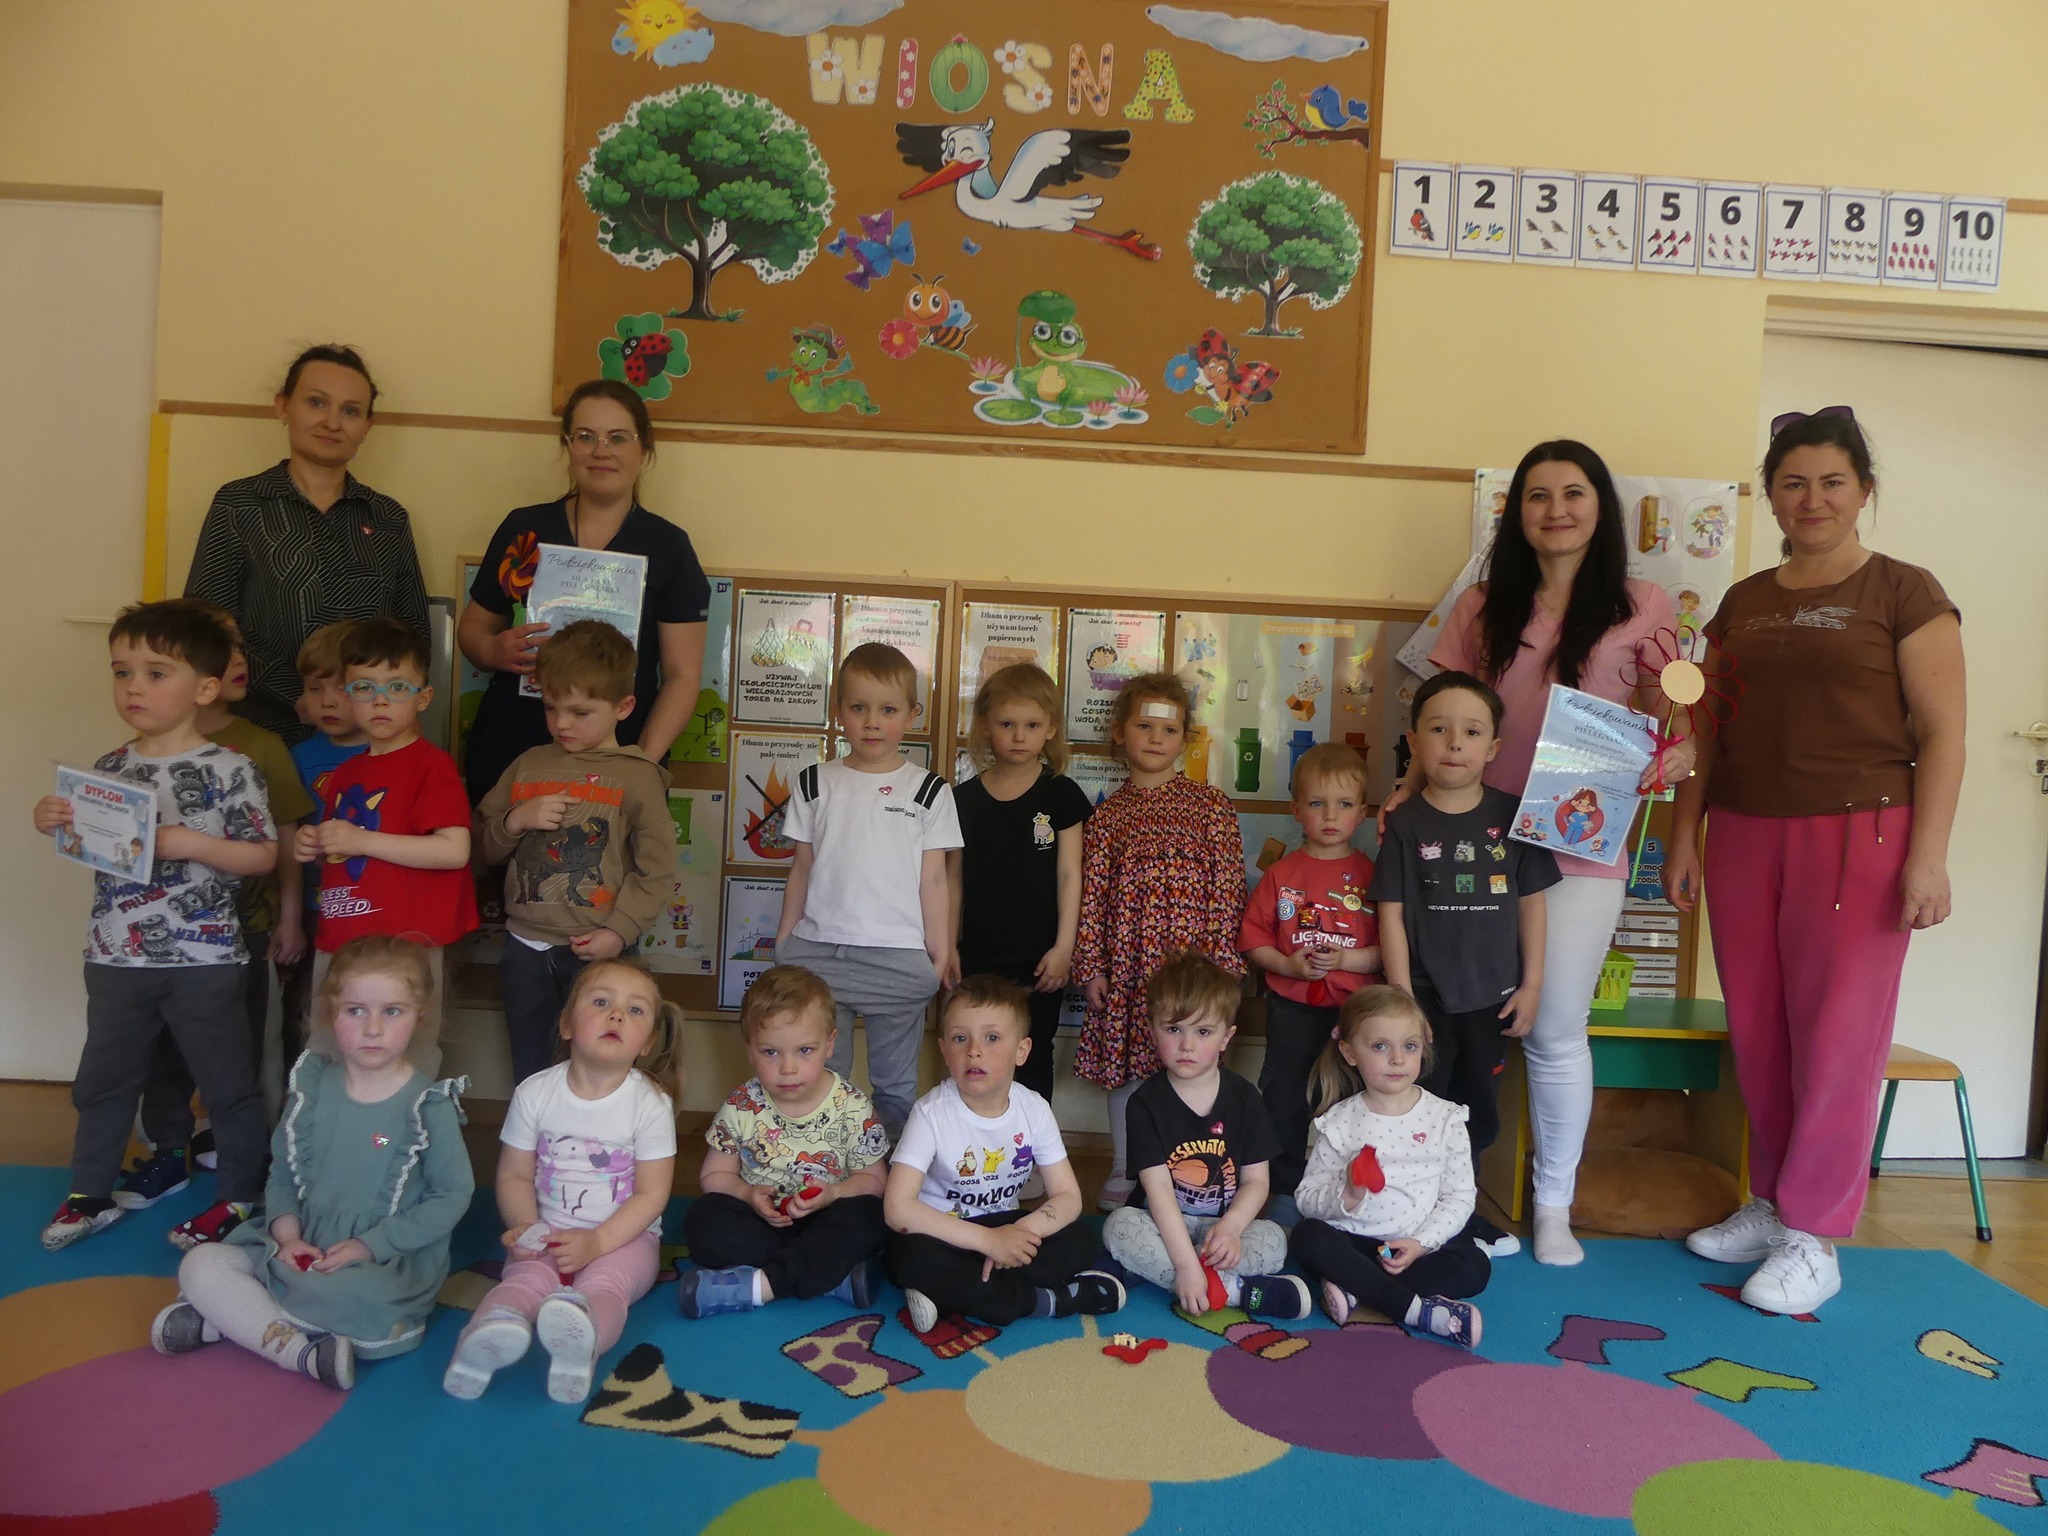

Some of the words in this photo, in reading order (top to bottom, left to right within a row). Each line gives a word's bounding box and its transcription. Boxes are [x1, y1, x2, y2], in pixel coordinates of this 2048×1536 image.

[806, 33, 1195, 123] WIOSNA
[1413, 175, 1431, 204] 1
[1474, 179, 1496, 209] 2
[1535, 184, 1558, 213] 3
[1597, 189, 1620, 218] 4
[1660, 192, 1681, 221] 5
[1720, 196, 1741, 225] 6
[1782, 200, 1804, 229] 7
[1844, 202, 1866, 232] 8
[1904, 207, 1924, 237] 9
[1952, 210, 1994, 240] 10
[981, 611, 1002, 619] Dbam
[986, 623, 1017, 632] używam
[1018, 623, 1039, 632] toreb
[988, 634, 1036, 644] papierowych
[743, 695, 770, 703] TOREB
[788, 697, 818, 705] ZAKUPY
[746, 688, 813, 697] WIELORAZOWYCH
[742, 739, 764, 747] Dbam
[760, 751, 775, 759] palę
[777, 751, 800, 759] śmieci
[85, 784, 124, 804] DYPLOM
[1648, 842, 1655, 851] 5
[323, 901, 367, 917] SPEED
